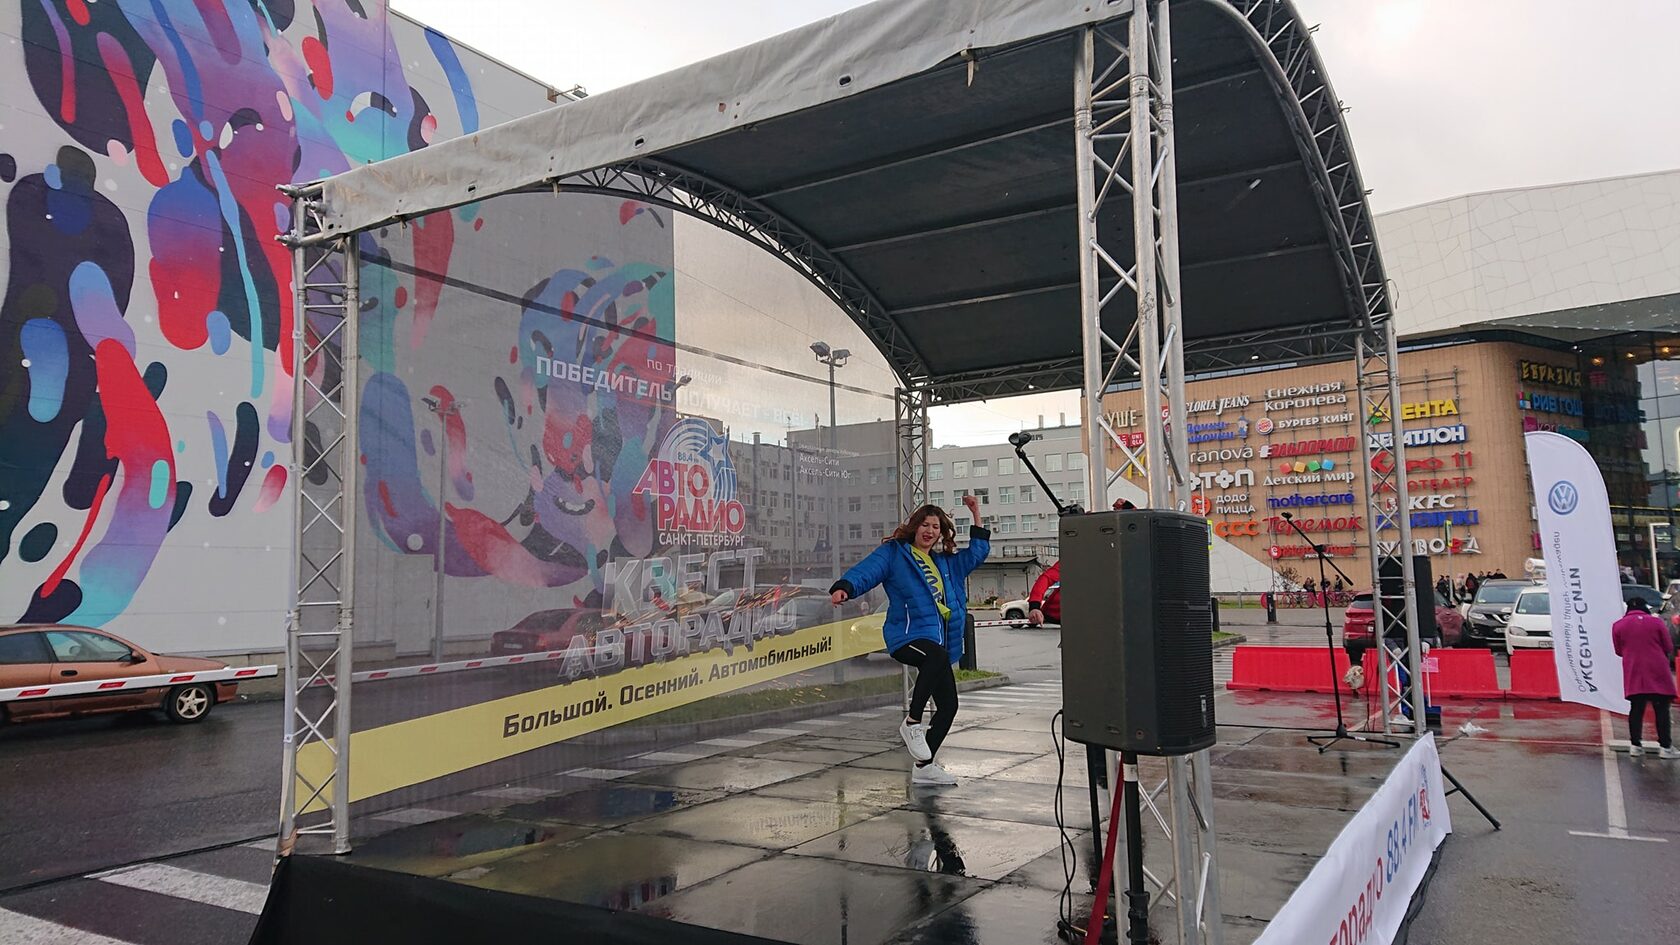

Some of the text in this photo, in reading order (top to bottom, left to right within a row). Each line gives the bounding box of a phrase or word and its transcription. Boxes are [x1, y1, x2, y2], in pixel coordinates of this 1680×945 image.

[647, 359, 663, 371] ПО
[536, 356, 672, 401] ПОБЕДИТЕЛЬ
[1216, 395, 1250, 415] JEANS
[1107, 409, 1137, 428] УШЕ
[1279, 417, 1319, 428] БУРГЕР
[1323, 413, 1355, 424] КИНГ
[1190, 447, 1254, 463] ranova
[1452, 451, 1473, 468] 11
[632, 457, 710, 499] АВТО
[1263, 471, 1355, 486] Детский мир
[1216, 494, 1247, 503] ДОДО
[1267, 493, 1355, 508] mothercare
[1408, 494, 1456, 510] KFC
[657, 495, 746, 534] РАДИО
[1216, 506, 1256, 515] ПИЦЦА
[1262, 516, 1364, 536] Теремок
[658, 533, 745, 547] САНКТ-ПЕТЕРБУРГ
[602, 548, 764, 618] КВЕСТ
[558, 599, 798, 680] АВТОРАДИО
[503, 636, 833, 738] Большой. Осенний. Автомобильный!
